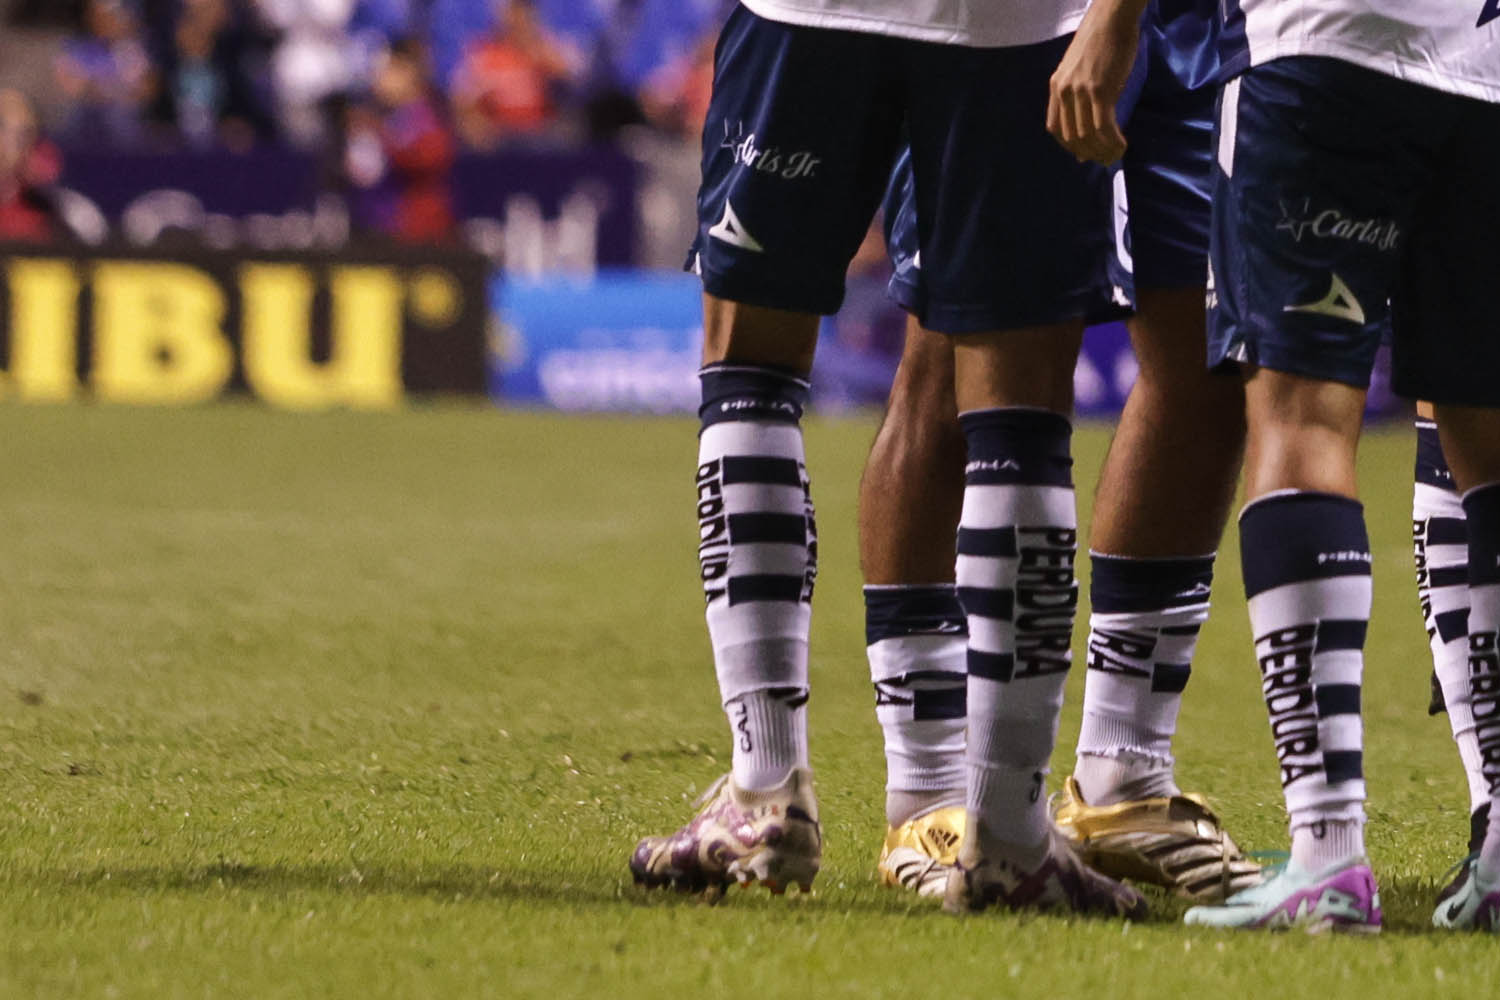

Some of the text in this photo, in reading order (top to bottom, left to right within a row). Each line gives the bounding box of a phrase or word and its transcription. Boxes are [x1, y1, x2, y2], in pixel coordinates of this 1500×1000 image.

[0, 257, 404, 405] IBU
[1014, 526, 1079, 680] PERDURA
[1254, 623, 1326, 788] PERDURA
